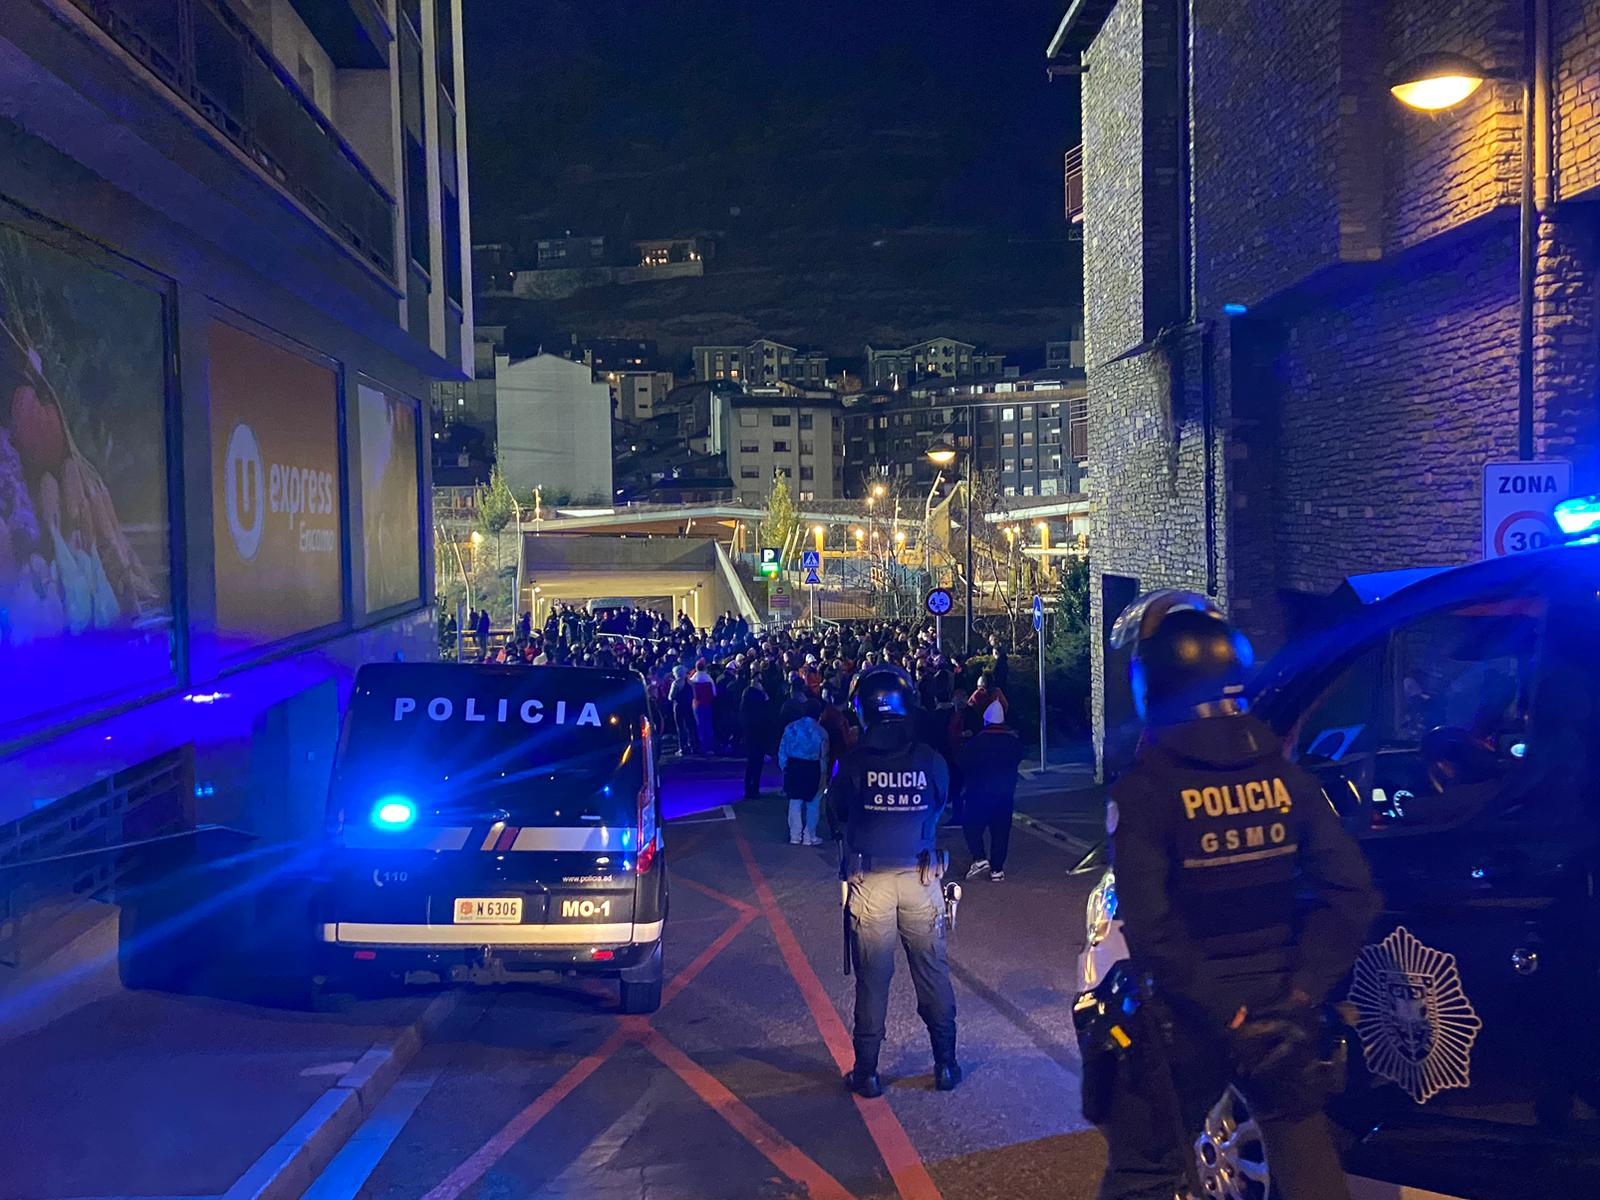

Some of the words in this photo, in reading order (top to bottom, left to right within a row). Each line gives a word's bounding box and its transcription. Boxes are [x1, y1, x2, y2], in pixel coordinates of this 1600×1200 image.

[1498, 475, 1557, 494] ZONA
[270, 463, 332, 530] express
[1510, 531, 1550, 551] 30
[763, 549, 775, 562] P
[393, 697, 602, 727] POLICIA
[867, 771, 927, 788] POLICIA
[1180, 778, 1292, 819] POLICIA
[383, 871, 408, 882] 110
[487, 902, 517, 915] 6306
[562, 900, 610, 917] MO-1
